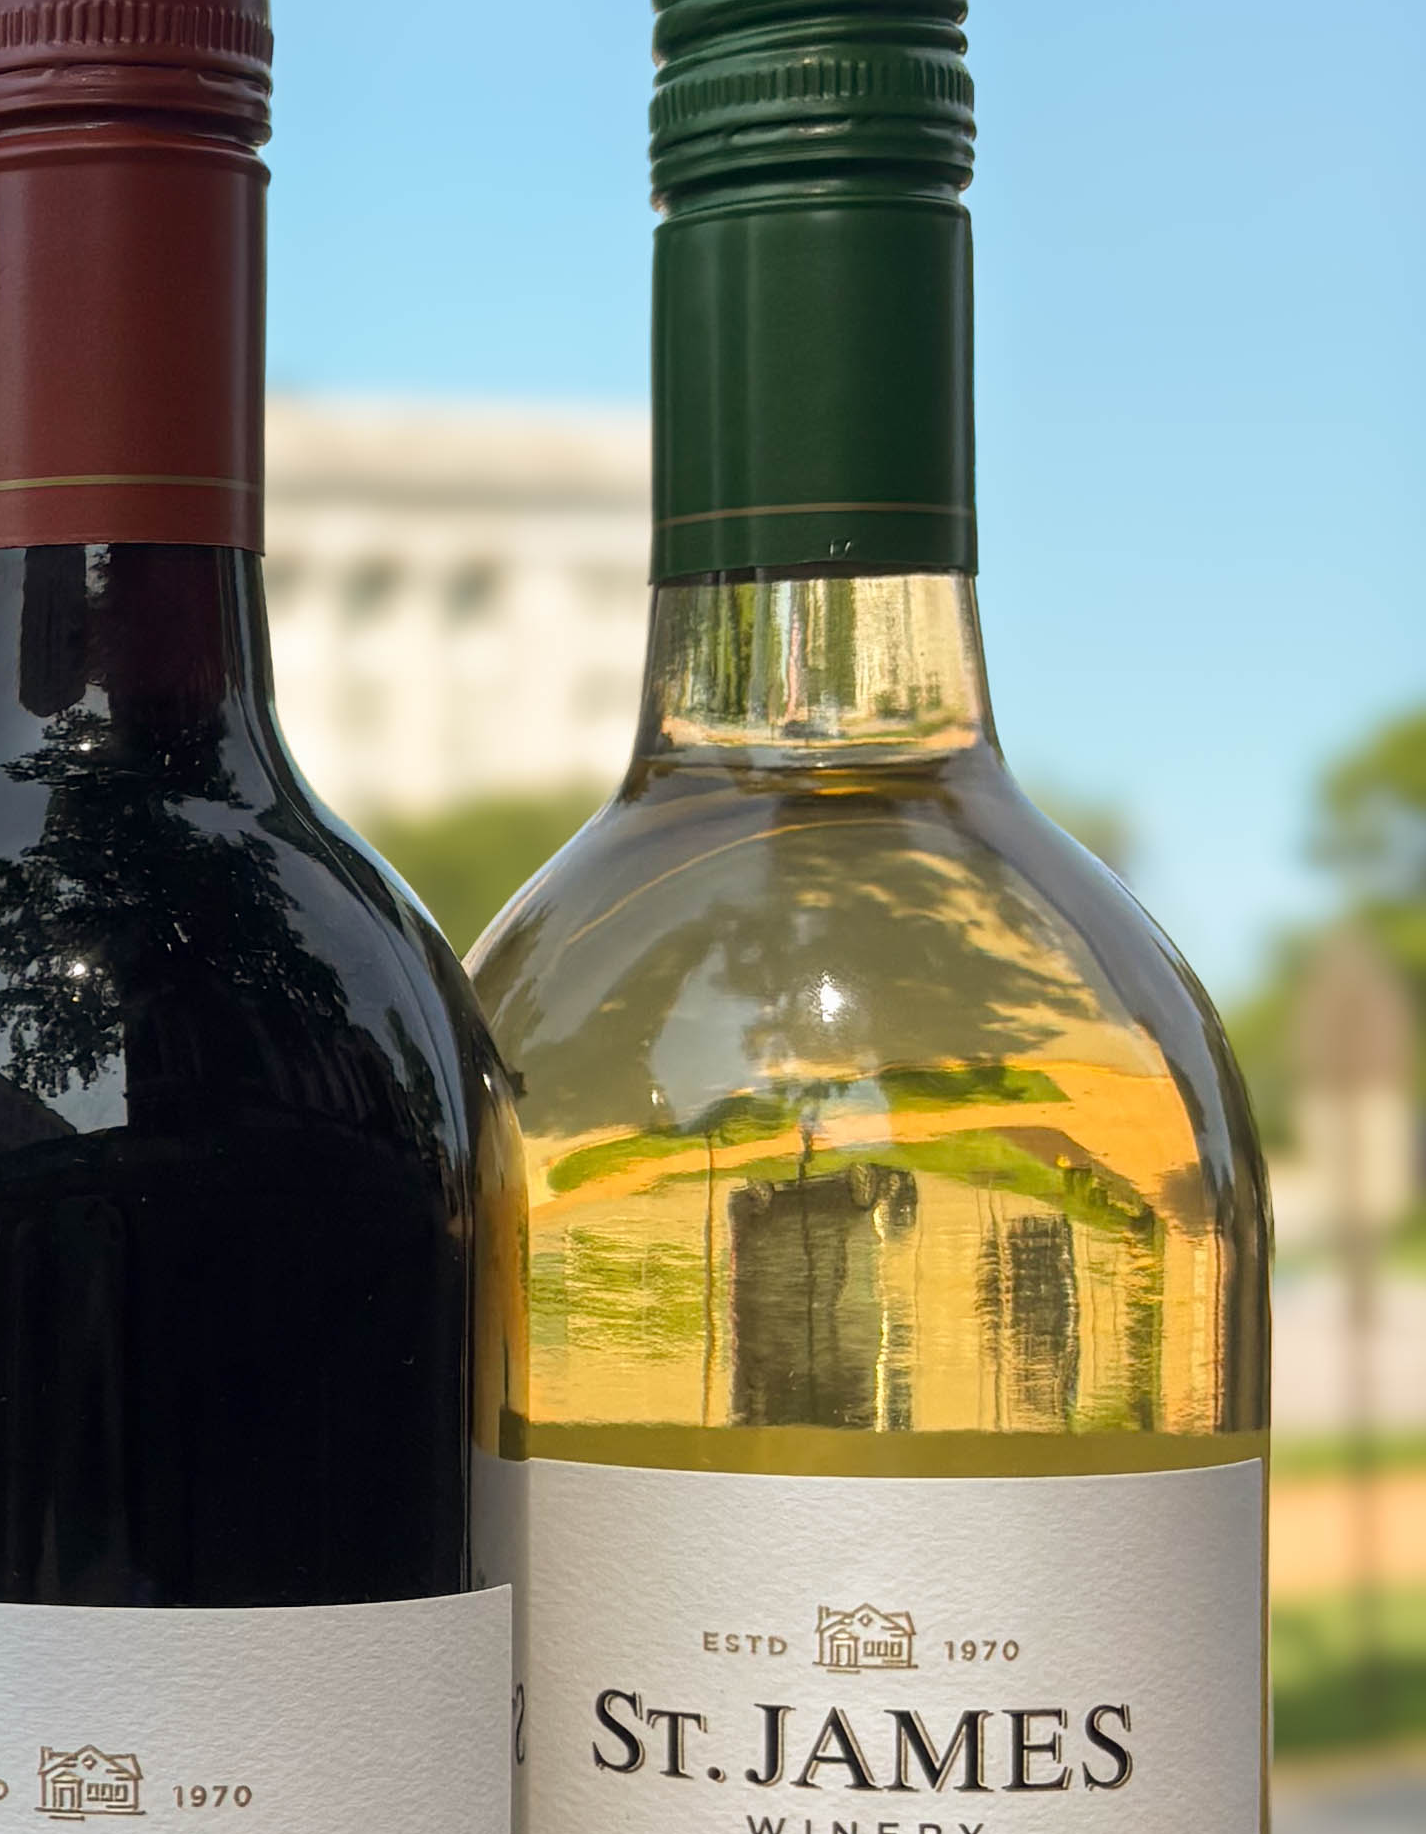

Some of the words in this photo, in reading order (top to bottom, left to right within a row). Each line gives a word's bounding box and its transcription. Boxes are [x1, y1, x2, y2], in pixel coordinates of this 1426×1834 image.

[703, 1632, 787, 1656] ESTD
[944, 1640, 1019, 1661] 1970
[744, 1703, 1133, 1793] JAMES
[173, 1785, 252, 1809] 1970
